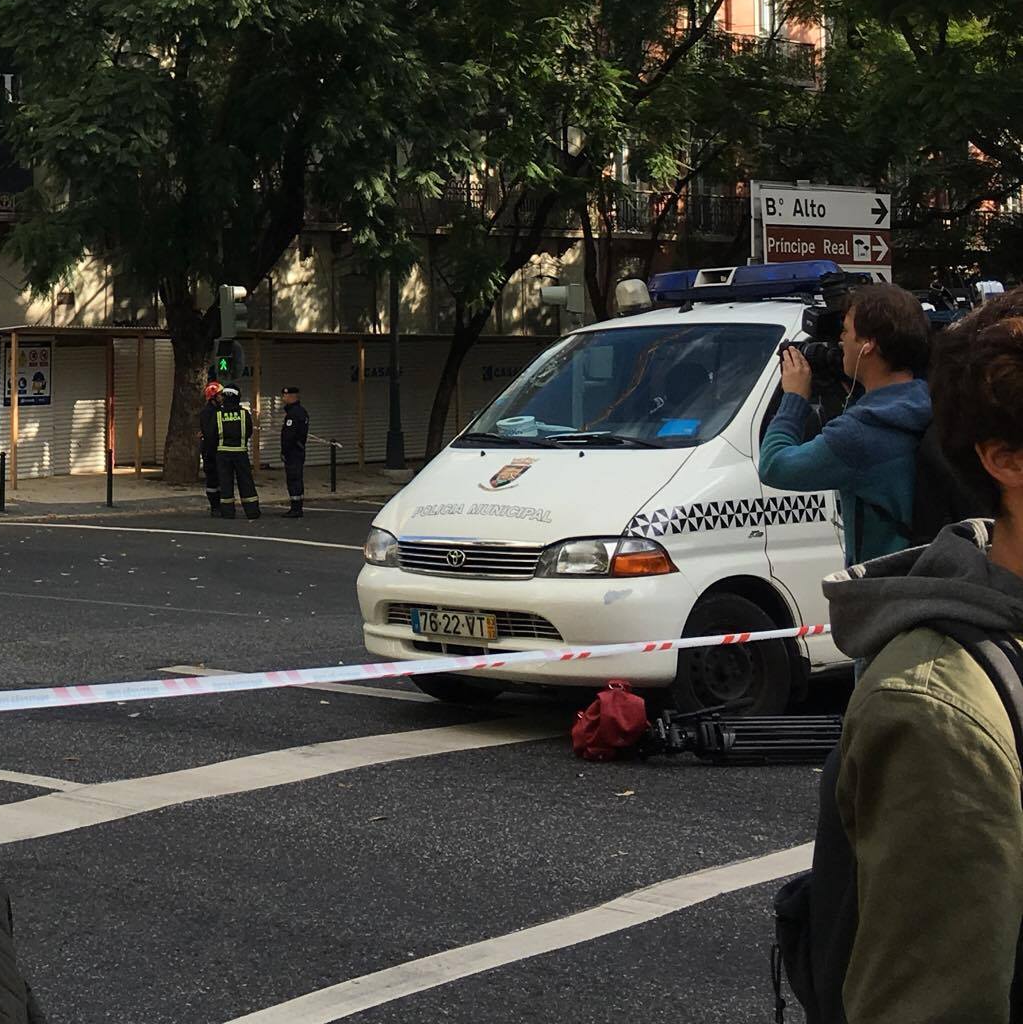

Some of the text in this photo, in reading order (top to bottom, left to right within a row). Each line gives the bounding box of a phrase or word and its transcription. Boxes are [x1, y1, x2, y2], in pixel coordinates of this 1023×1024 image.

[793, 198, 826, 218] Alto
[823, 238, 850, 256] Real
[466, 503, 553, 524] MUNICIPAL
